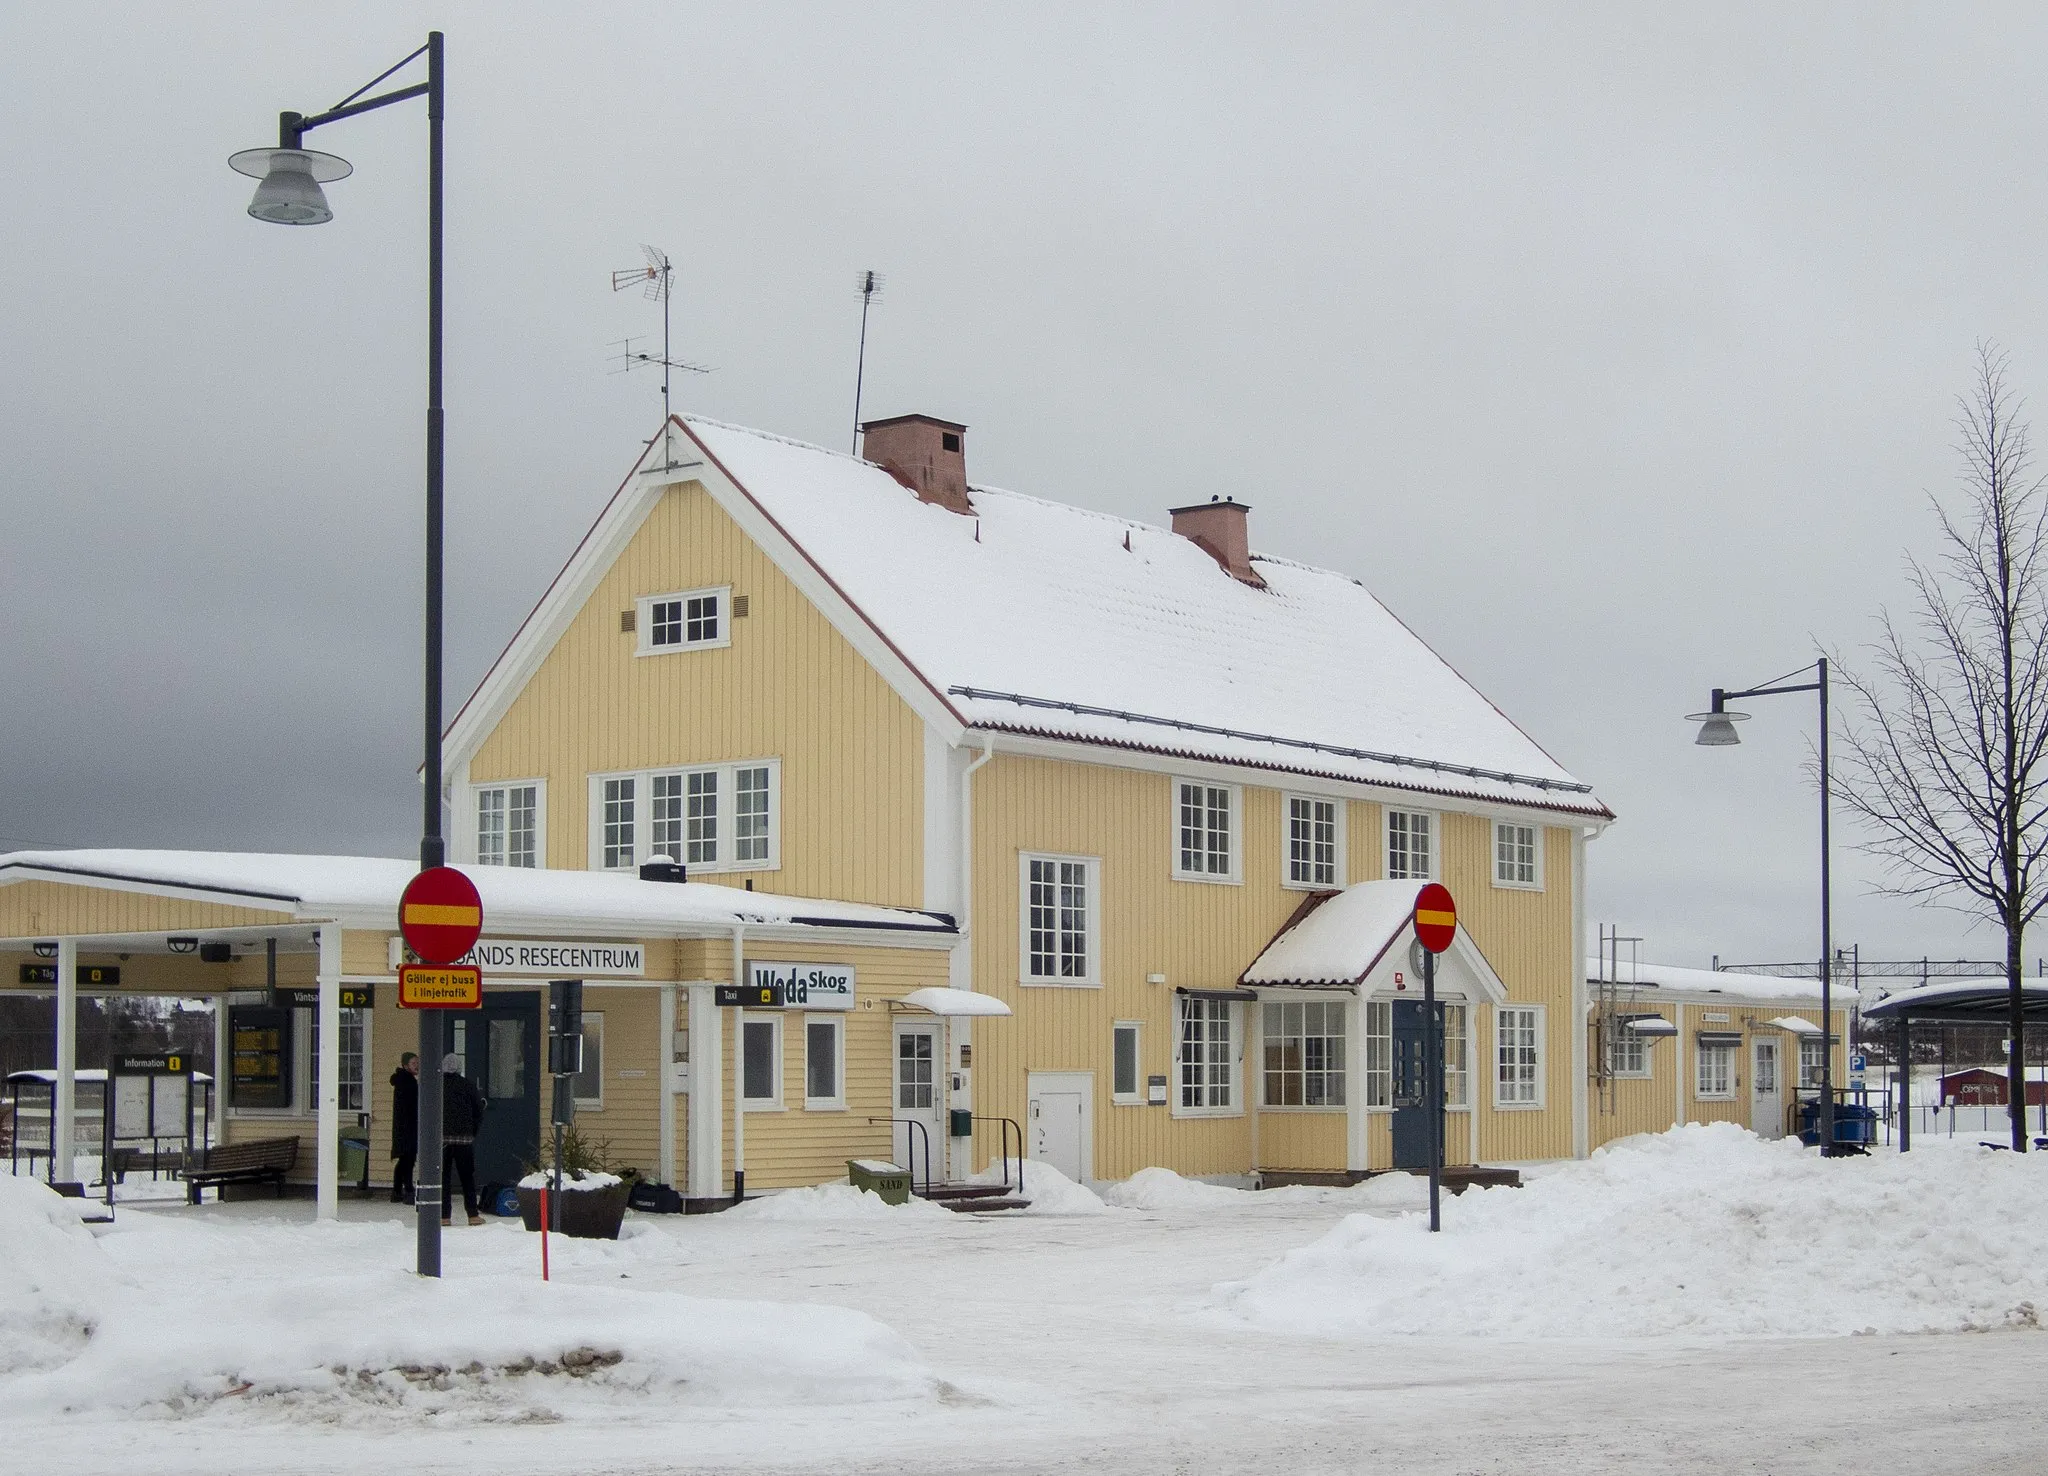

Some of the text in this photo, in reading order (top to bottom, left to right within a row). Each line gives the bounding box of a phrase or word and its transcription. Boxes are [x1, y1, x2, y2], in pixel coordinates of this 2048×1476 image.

[520, 947, 639, 968] RESECENTRUM
[42, 969, 55, 980] Tåg
[406, 974, 475, 986] Gäller ej buss
[809, 971, 847, 994] Skog
[294, 992, 320, 1002] Väntsa
[420, 987, 467, 999] linjetrafik
[724, 990, 737, 1000] Taxi
[124, 1058, 165, 1068] Information
[1852, 1057, 1861, 1070] P
[880, 1179, 903, 1191] SAND
